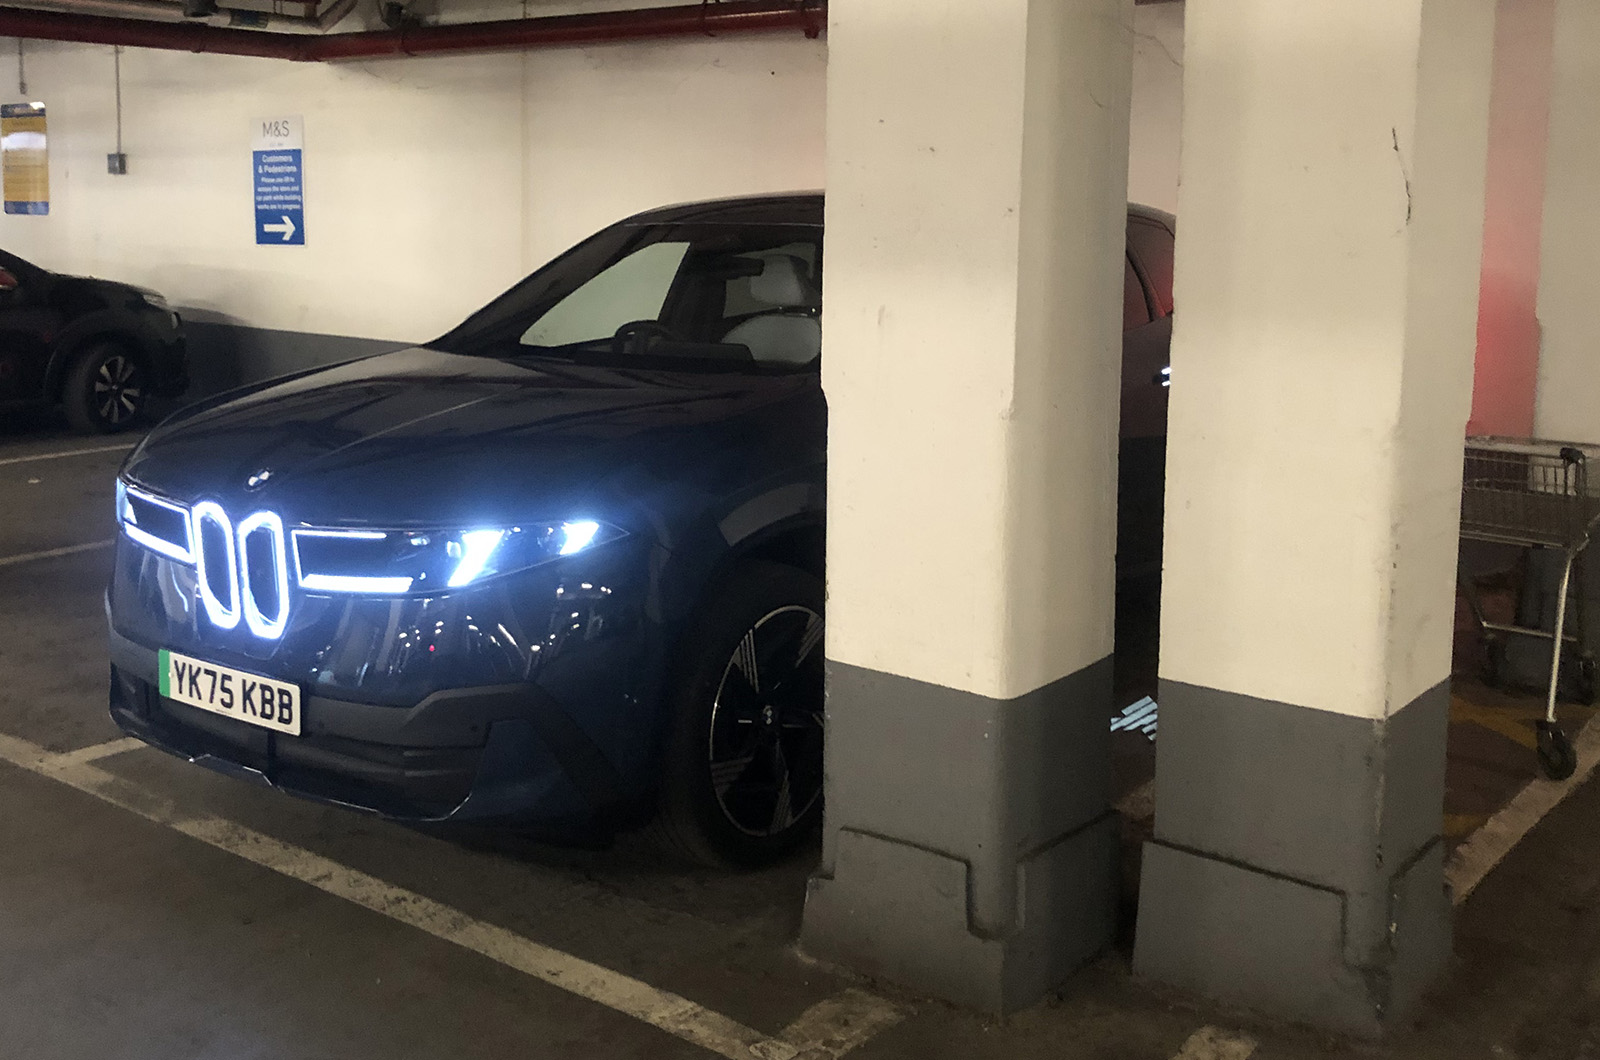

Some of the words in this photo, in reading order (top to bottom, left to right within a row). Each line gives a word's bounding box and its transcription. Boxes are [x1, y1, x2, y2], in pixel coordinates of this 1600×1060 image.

[262, 120, 290, 138] M&S
[262, 154, 293, 163] Customers
[264, 165, 297, 173] Pedestrians
[174, 659, 234, 709] YK75
[242, 678, 293, 725] KBB
